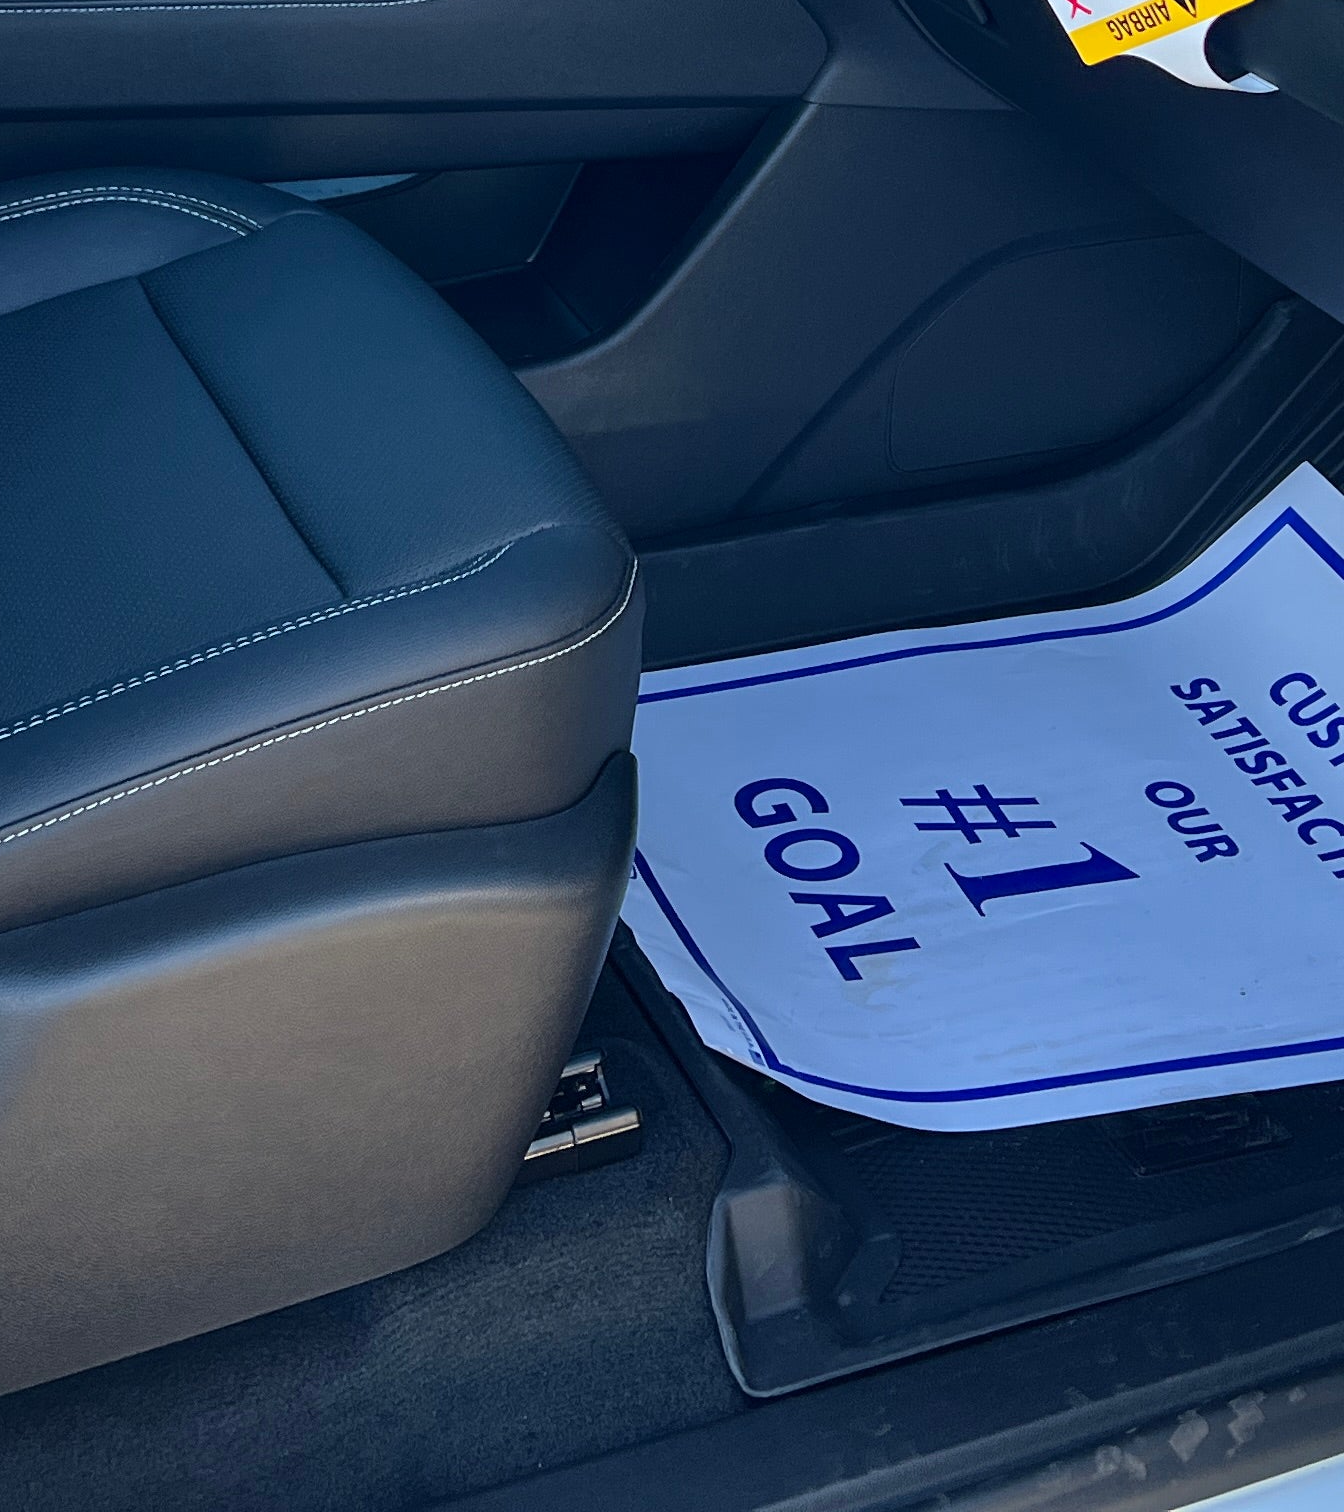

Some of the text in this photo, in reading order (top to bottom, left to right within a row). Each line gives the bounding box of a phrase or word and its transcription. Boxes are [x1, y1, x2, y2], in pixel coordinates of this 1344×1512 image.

[733, 776, 922, 982] GOAL
[899, 782, 1141, 919] #1
[1144, 779, 1241, 863] OUR
